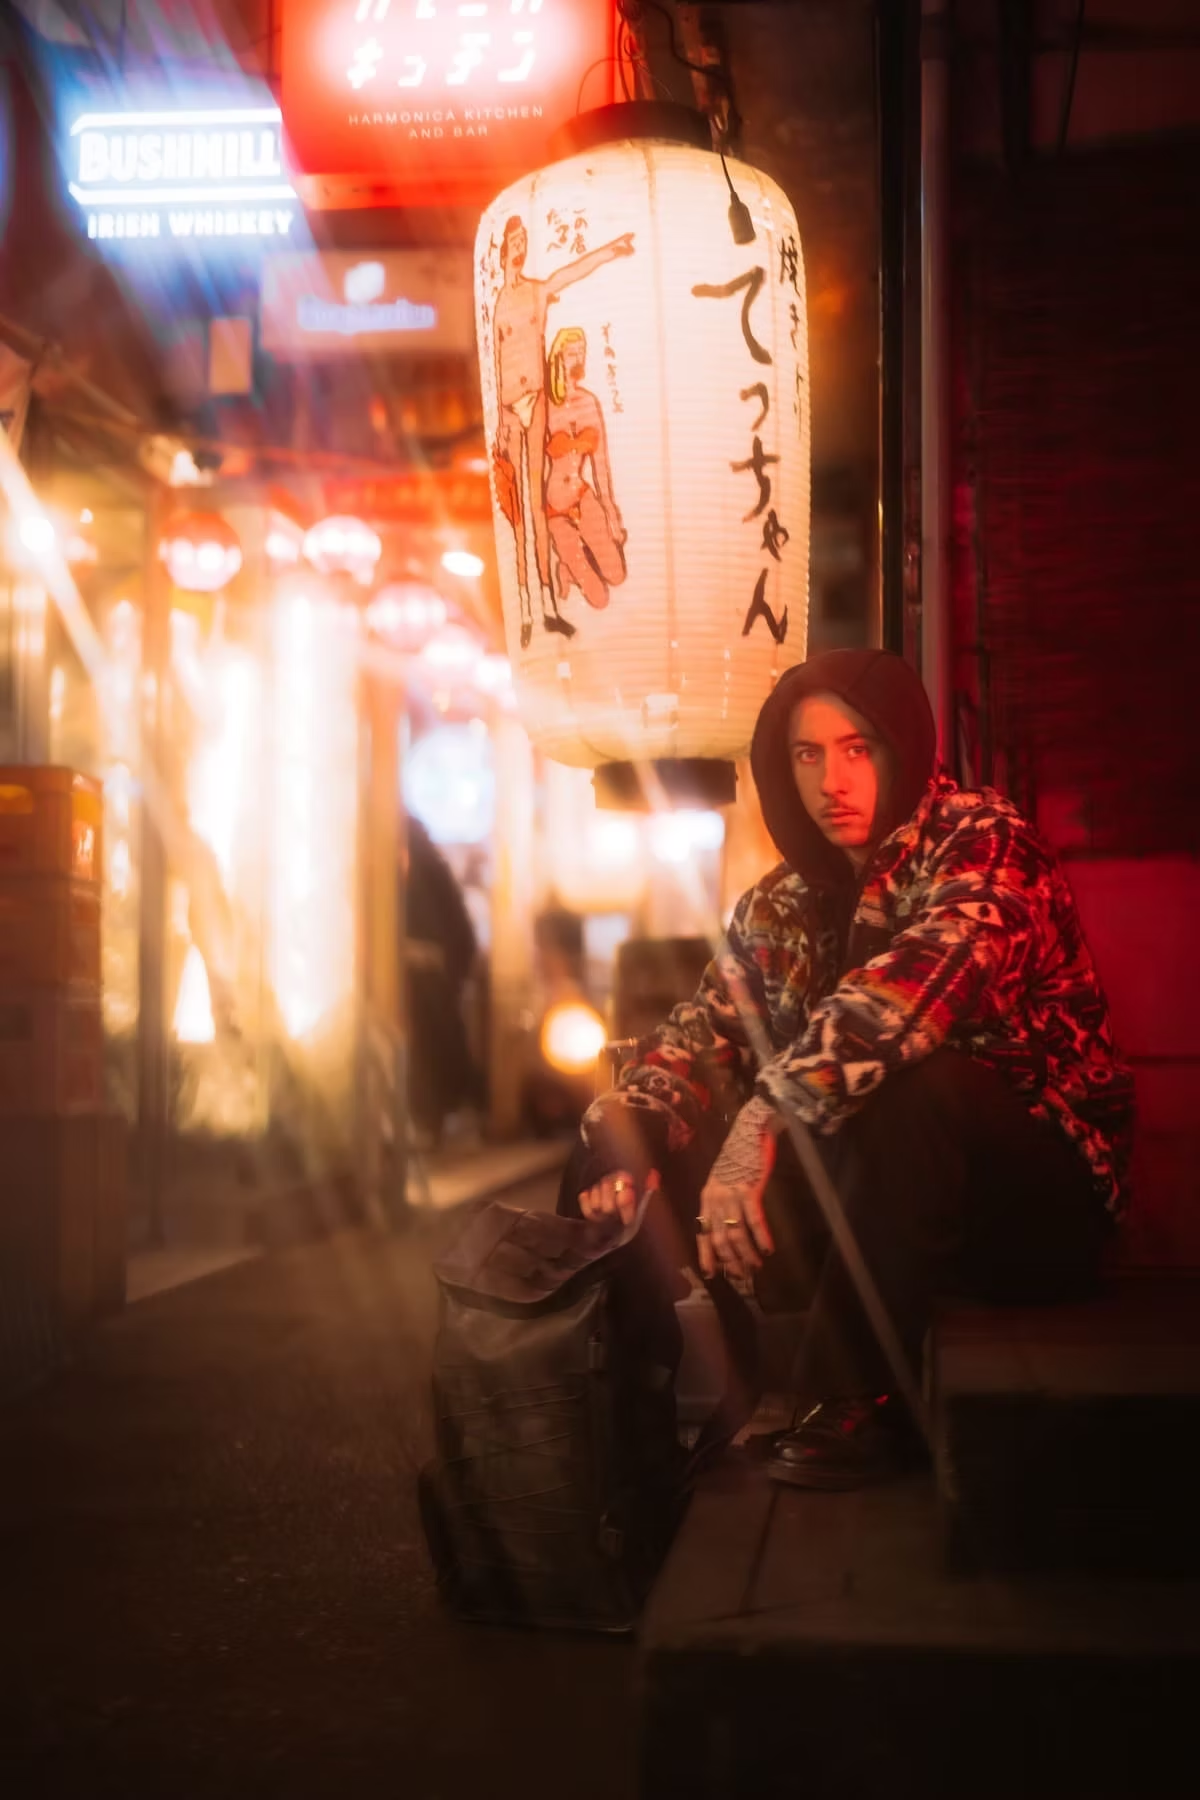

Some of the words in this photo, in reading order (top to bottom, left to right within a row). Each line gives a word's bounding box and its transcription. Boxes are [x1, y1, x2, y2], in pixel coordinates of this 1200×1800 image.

[348, 110, 456, 126] HARMONICA
[464, 105, 544, 121] KITCHEN
[408, 127, 444, 140] AND
[453, 125, 489, 138] BAR
[78, 130, 281, 183] BUSHMILL
[87, 211, 160, 240] IRISH
[167, 208, 294, 236] WHISKEY
[691, 265, 790, 645] てっちゃん
